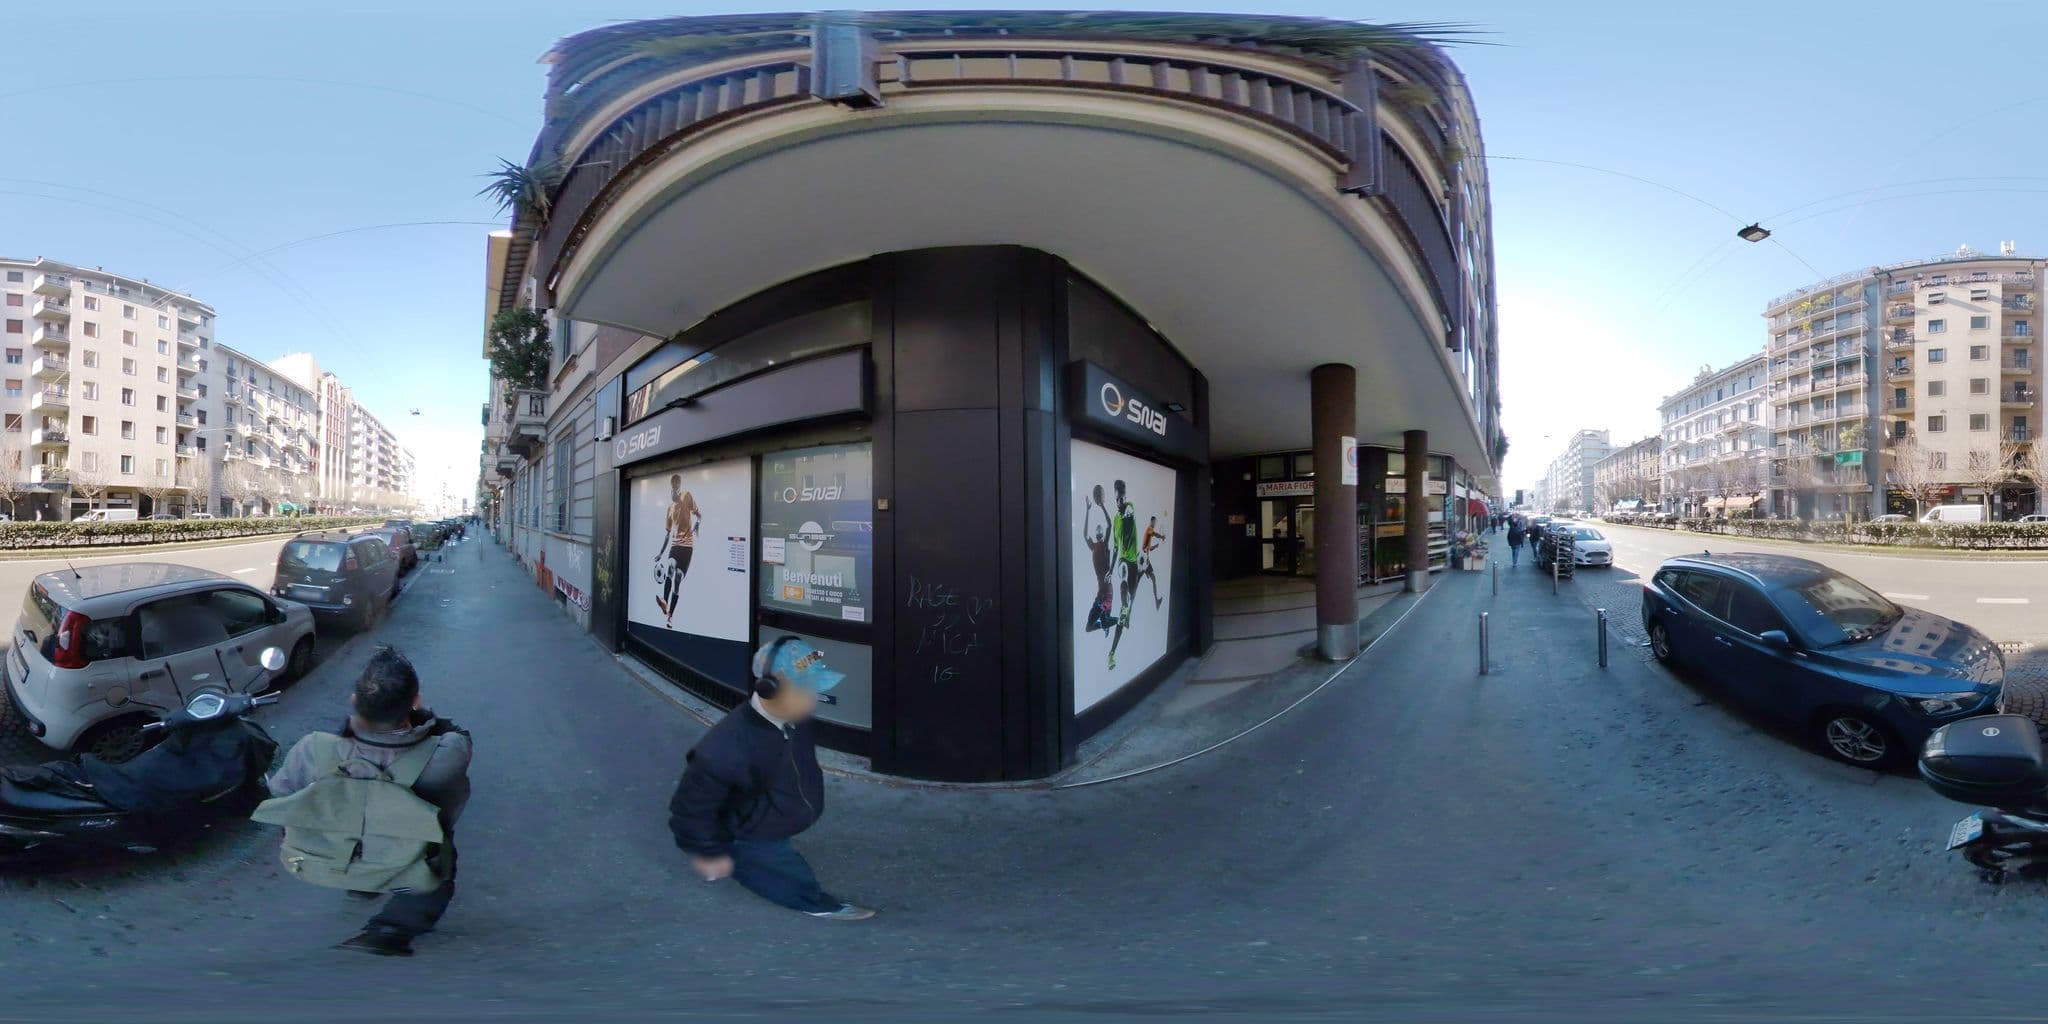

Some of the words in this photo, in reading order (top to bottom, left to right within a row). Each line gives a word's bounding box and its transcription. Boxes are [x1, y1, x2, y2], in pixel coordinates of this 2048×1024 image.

[1126, 398, 1167, 436] SNAI
[628, 424, 661, 455] SNAI
[800, 486, 842, 502] SNAI
[1266, 482, 1292, 491] MARIA
[783, 568, 843, 588] Benvenuti
